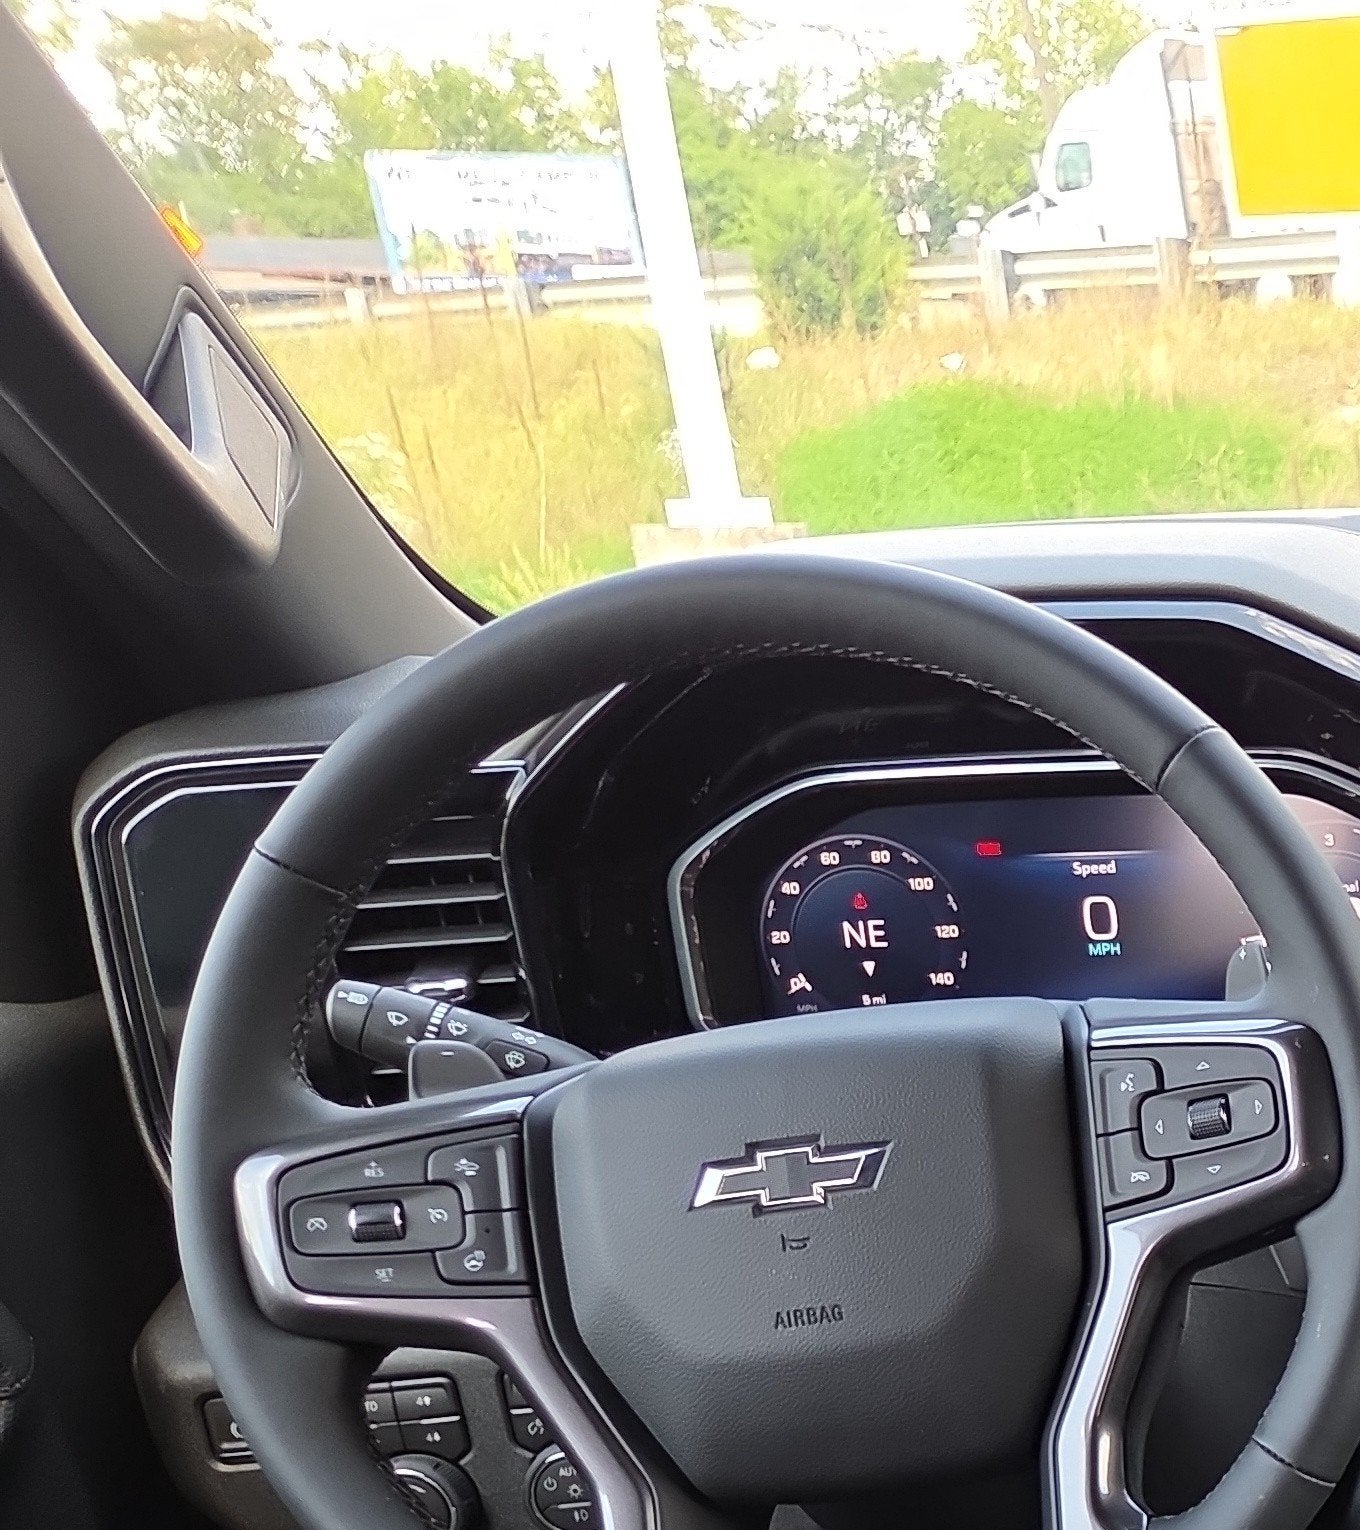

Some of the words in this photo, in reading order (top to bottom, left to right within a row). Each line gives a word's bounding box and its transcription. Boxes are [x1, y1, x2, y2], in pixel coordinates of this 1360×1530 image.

[1324, 833, 1335, 847] 3
[820, 851, 840, 866] 60
[870, 850, 891, 865] 80
[1072, 860, 1116, 878] Speed
[781, 881, 800, 896] 40
[908, 877, 934, 891] 100
[1083, 896, 1118, 940] 0
[770, 931, 791, 945] 20
[842, 919, 889, 949] NE
[935, 925, 959, 939] 120
[1088, 942, 1121, 956] MPH
[929, 972, 955, 985] 140
[774, 1304, 844, 1330] AIRBAG
